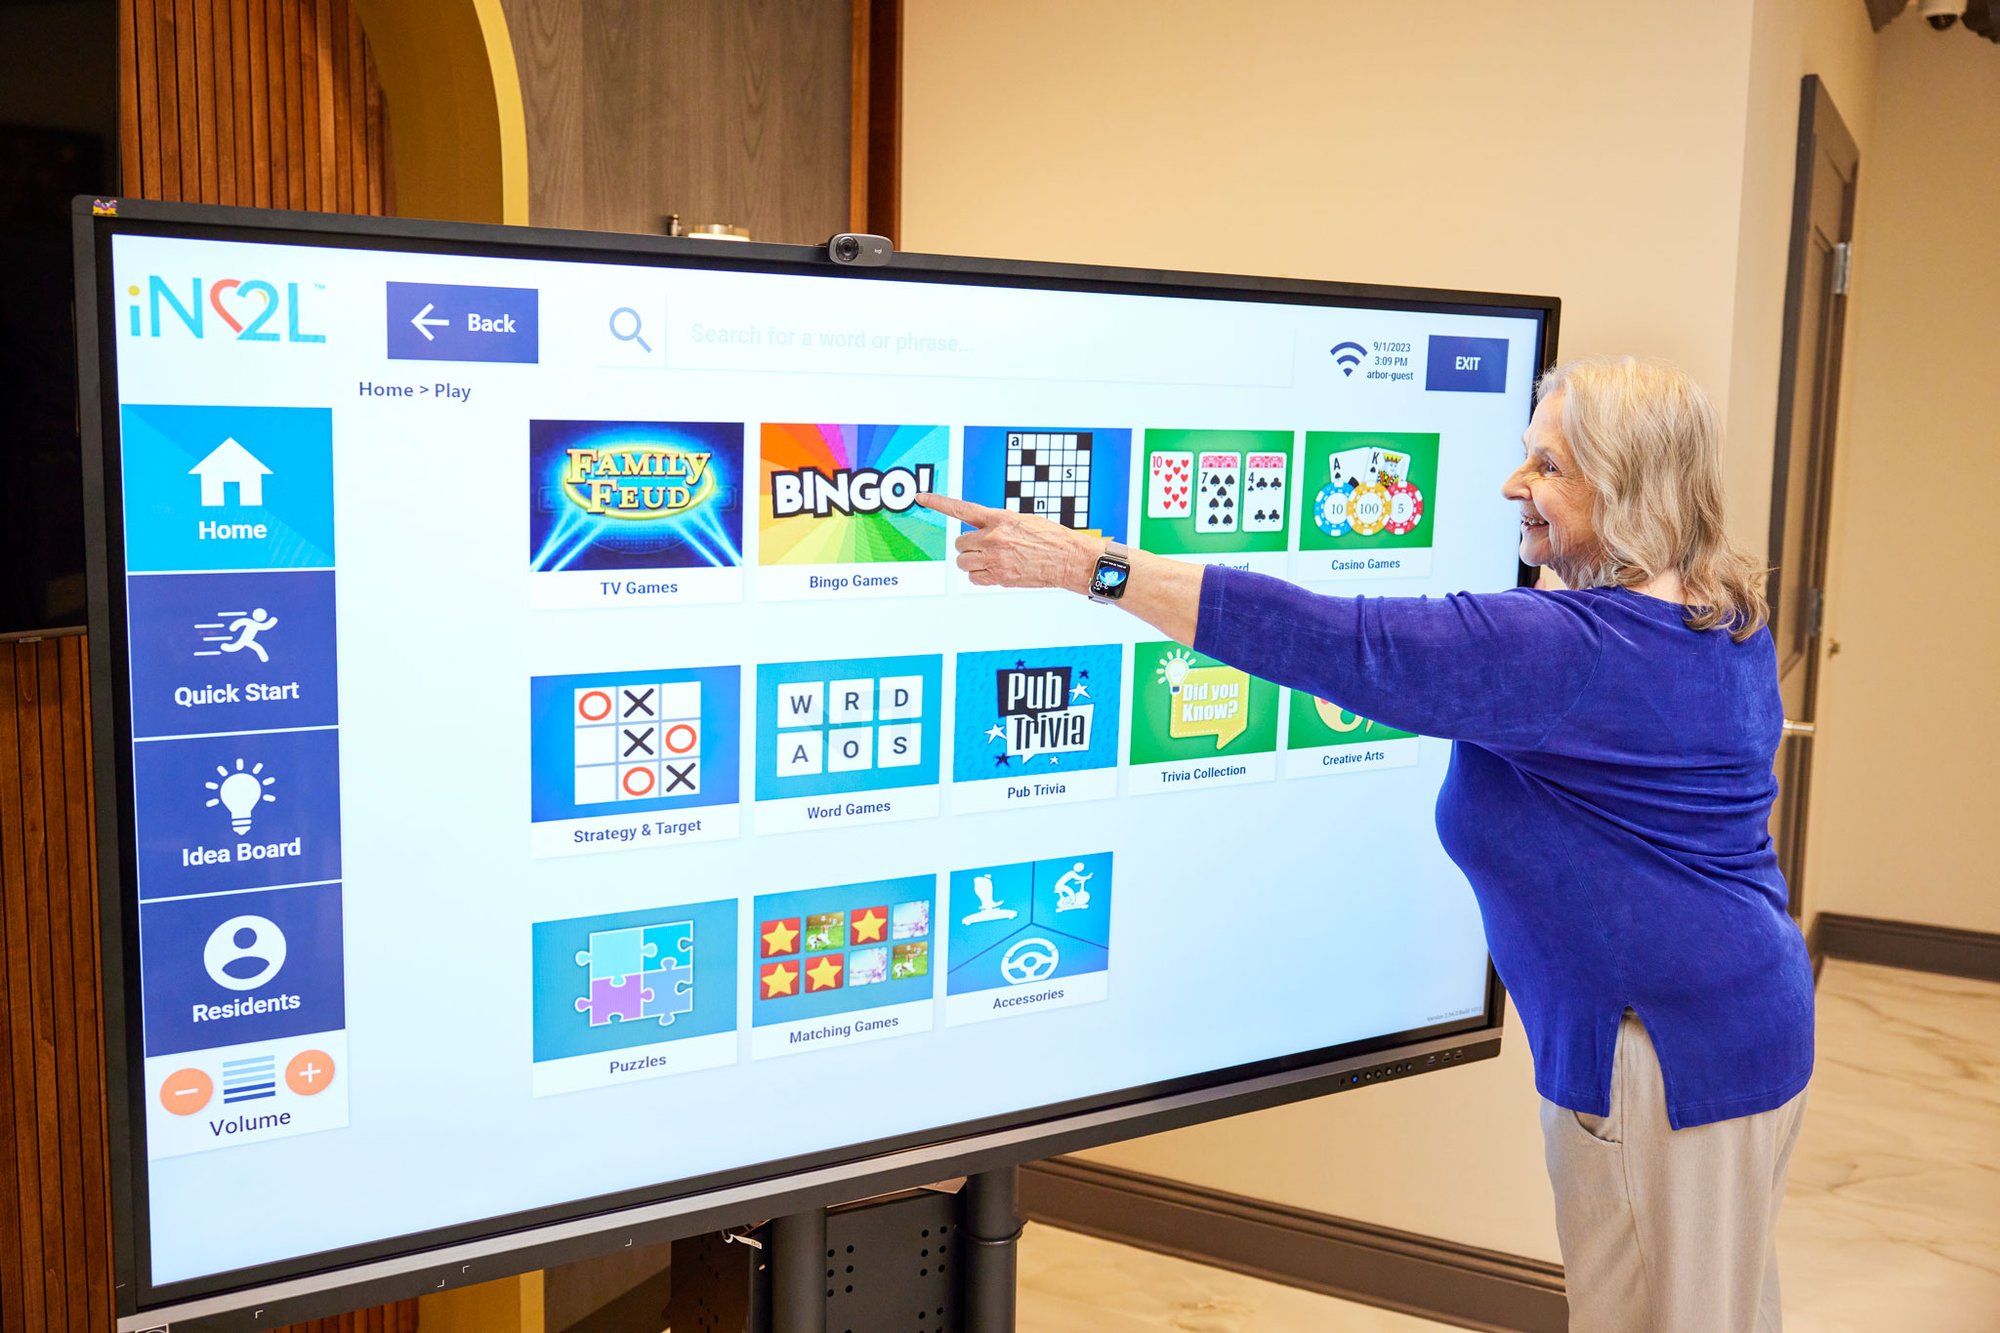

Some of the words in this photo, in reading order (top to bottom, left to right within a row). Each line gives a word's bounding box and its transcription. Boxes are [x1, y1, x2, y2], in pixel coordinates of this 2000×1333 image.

[467, 312, 516, 335] Back
[690, 323, 761, 345] Search
[768, 326, 796, 346] for
[801, 332, 813, 347] a
[819, 330, 866, 349] word
[871, 334, 890, 349] or
[896, 332, 974, 355] phrase...
[1373, 342, 1411, 352] 9/1/2023
[1374, 357, 1392, 366] 3:09
[1394, 357, 1408, 366] PM
[1455, 356, 1481, 371] EXIT
[1367, 369, 1414, 381] arbor-guest
[358, 382, 413, 398] Home
[434, 382, 471, 402] Play
[1011, 436, 1019, 446] a
[1152, 455, 1163, 468] 10
[1333, 457, 1341, 471] A
[1371, 452, 1379, 465] K
[1066, 468, 1072, 478] s
[1201, 472, 1208, 484] 7
[1248, 472, 1254, 484] 4
[587, 479, 691, 514] FEUD
[771, 464, 935, 519] BINGO!
[1036, 500, 1045, 510] n
[1331, 503, 1344, 514] 10
[1360, 503, 1379, 514] 100
[1397, 503, 1404, 514] 5
[199, 519, 267, 540] Home
[1331, 559, 1365, 570] Casino
[1367, 558, 1401, 570] Games
[600, 581, 620, 596] TV
[626, 580, 678, 596] Games
[809, 575, 848, 590] Bingo
[852, 574, 898, 588] Games
[174, 683, 240, 708] Quick
[245, 681, 300, 701] Start
[1007, 671, 1063, 711] Pub
[1182, 682, 1208, 701] Did
[1210, 682, 1239, 702] you
[790, 694, 812, 714] W
[845, 691, 859, 711] R
[894, 688, 909, 707] D
[1182, 700, 1239, 722] Know?
[1014, 713, 1085, 750] Trivia
[792, 744, 809, 763] A
[843, 740, 859, 759] O
[893, 736, 908, 755] S
[1322, 752, 1362, 766] Creative
[1364, 750, 1385, 763] Arts
[1161, 770, 1191, 783] Trivia
[1193, 765, 1246, 780] Collection
[1007, 786, 1031, 799] Pub
[1034, 783, 1066, 796] Trivia
[807, 805, 842, 819] Word
[845, 802, 891, 816] Games
[574, 824, 637, 843] Strategy
[641, 824, 651, 836] &
[656, 820, 702, 838] Target
[182, 846, 231, 867] Idea
[236, 837, 301, 862] Board
[992, 987, 1065, 1010] Accessories
[192, 993, 301, 1023] Residents
[789, 1023, 852, 1045] Matching
[855, 1015, 900, 1033] Games
[609, 1053, 667, 1074] Puzzles
[209, 1111, 292, 1137] Volume
